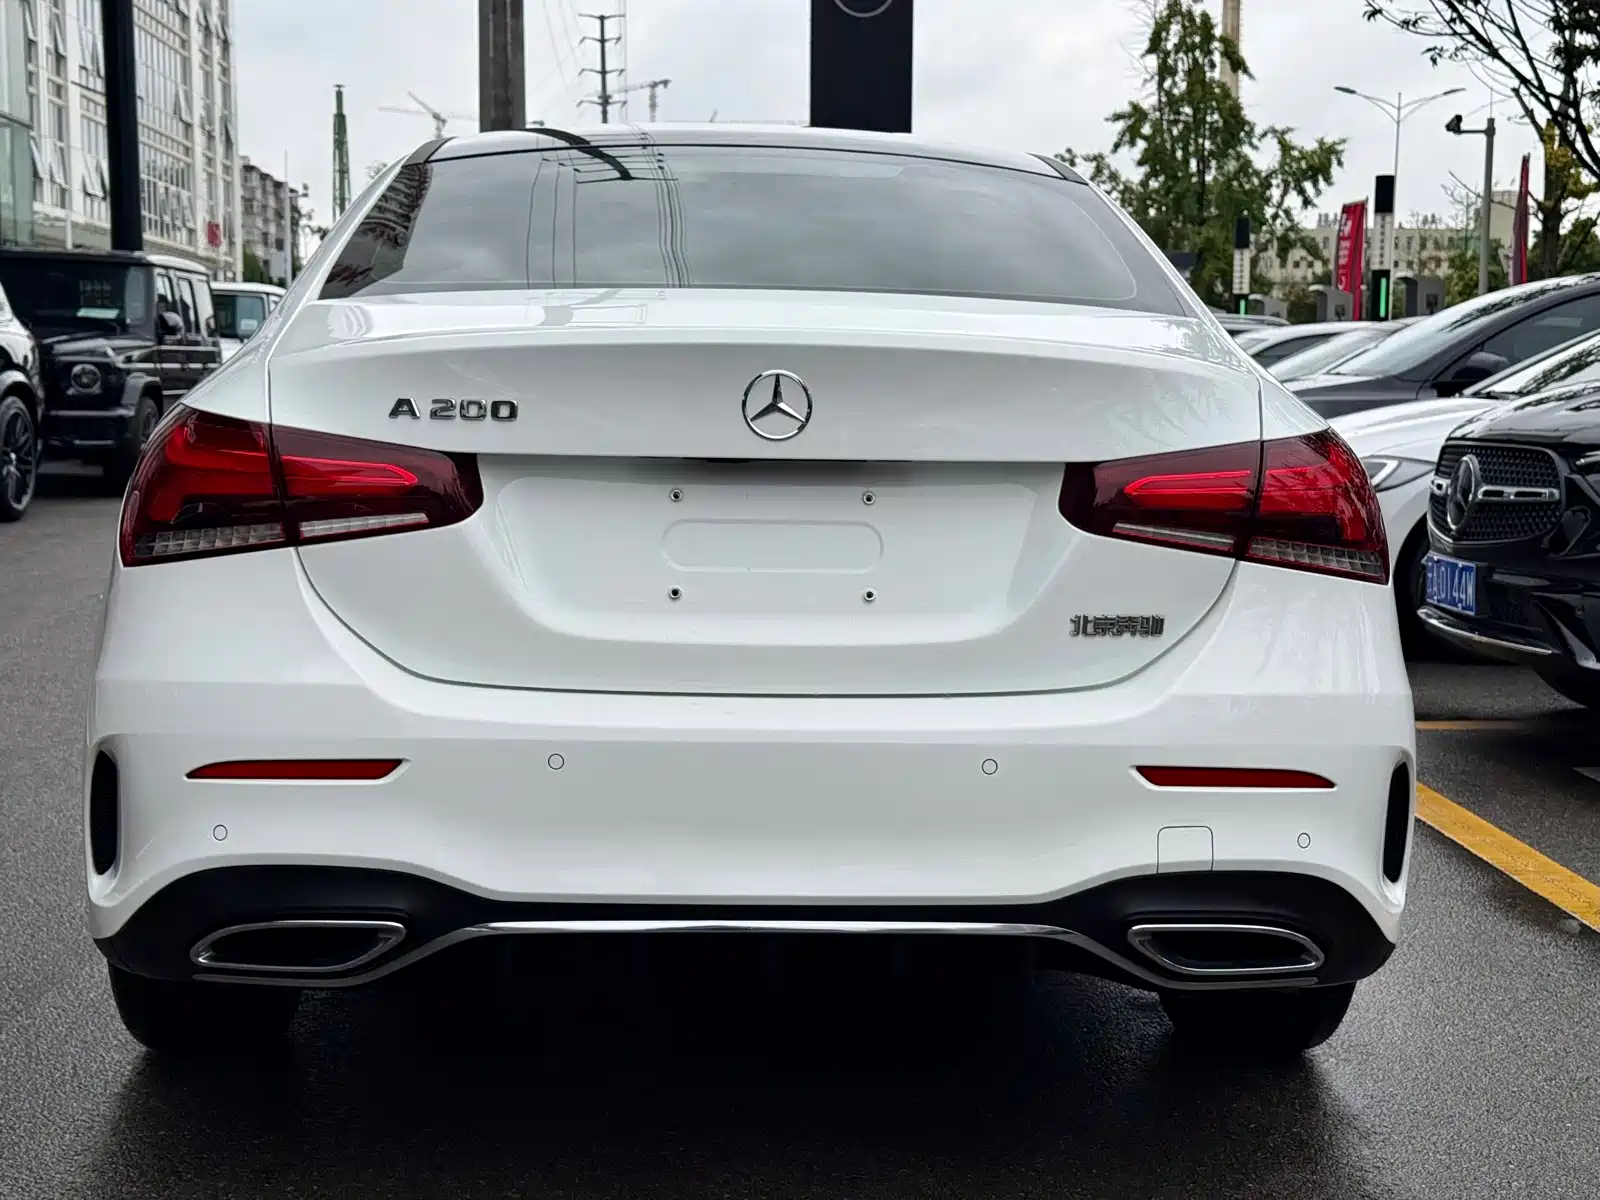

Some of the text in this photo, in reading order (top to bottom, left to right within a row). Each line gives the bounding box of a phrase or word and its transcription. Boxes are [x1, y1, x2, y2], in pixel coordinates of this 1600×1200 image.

[388, 397, 519, 422] A 200
[1069, 614, 1165, 637] 北京奔驰
